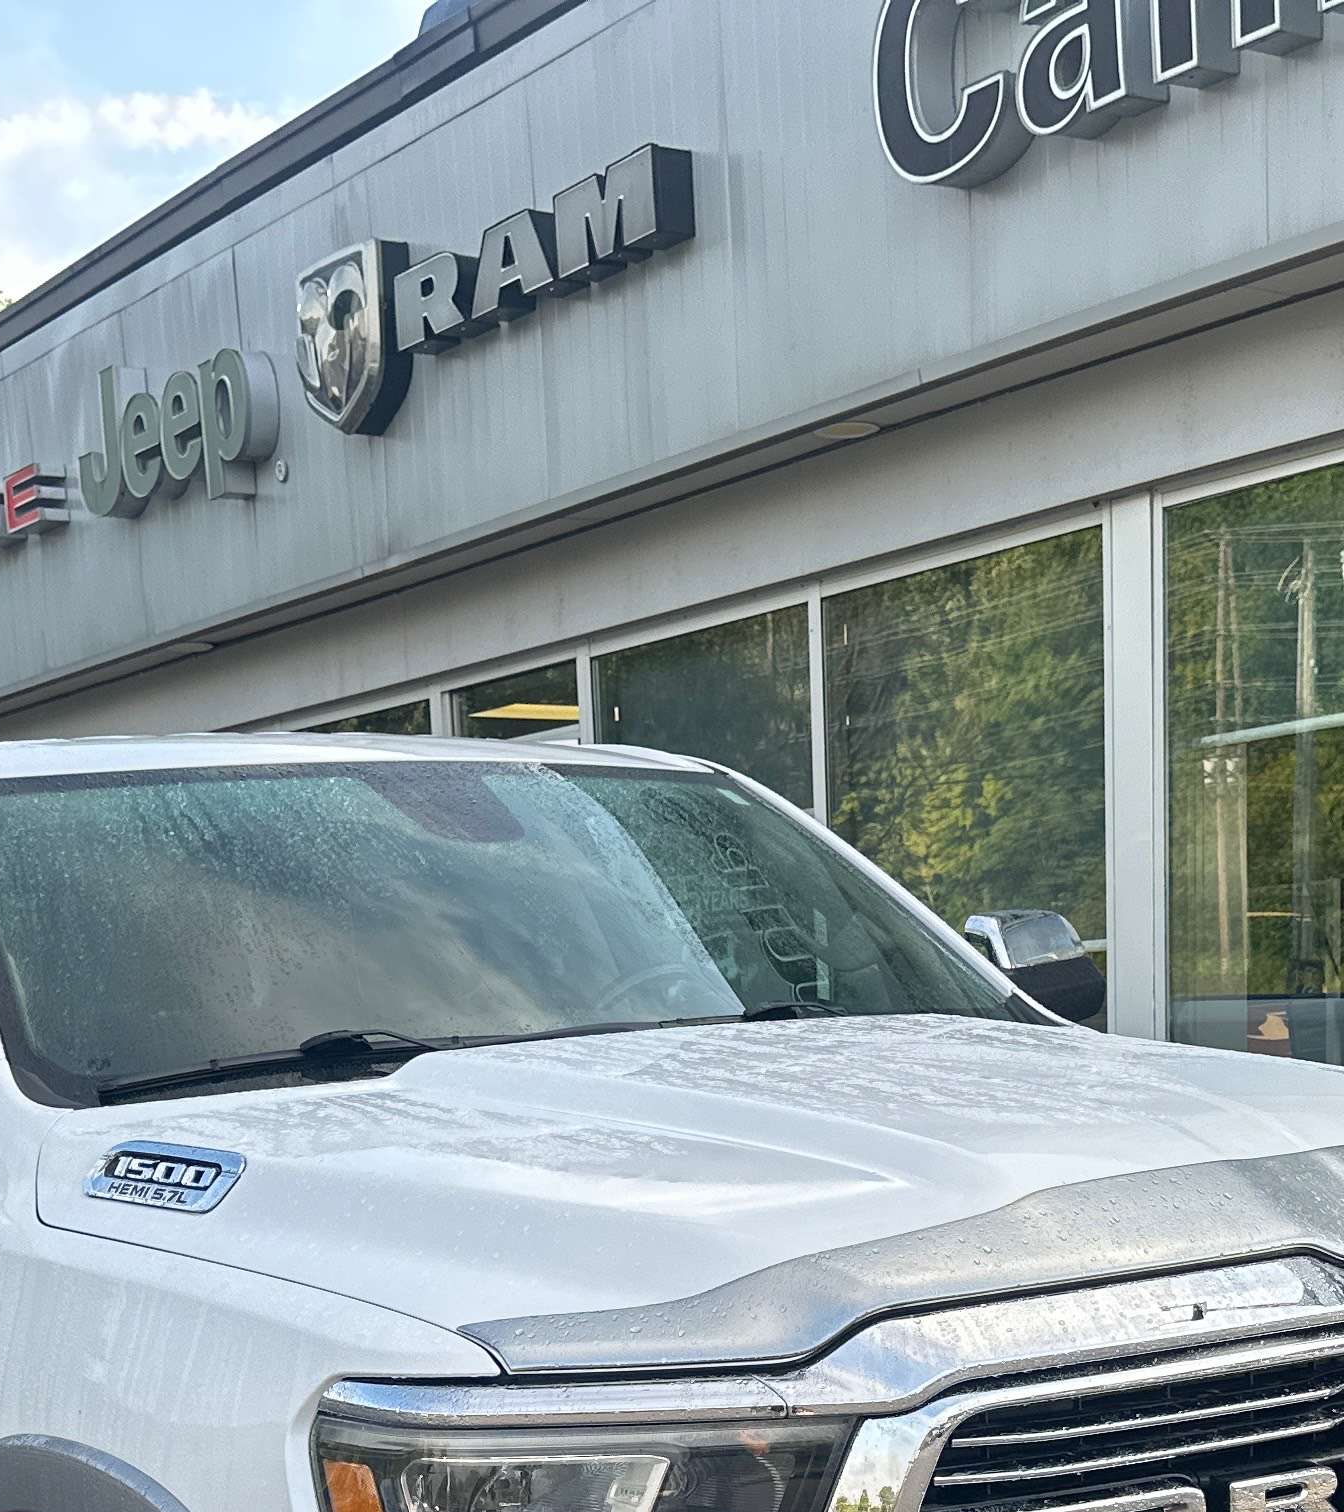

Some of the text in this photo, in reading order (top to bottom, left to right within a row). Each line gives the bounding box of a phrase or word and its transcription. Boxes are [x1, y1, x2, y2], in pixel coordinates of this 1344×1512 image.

[393, 143, 661, 353] RAM
[78, 348, 258, 518] Jeep
[107, 1181, 188, 1204] HEMI 5.7L
[112, 1155, 219, 1188] 1500
